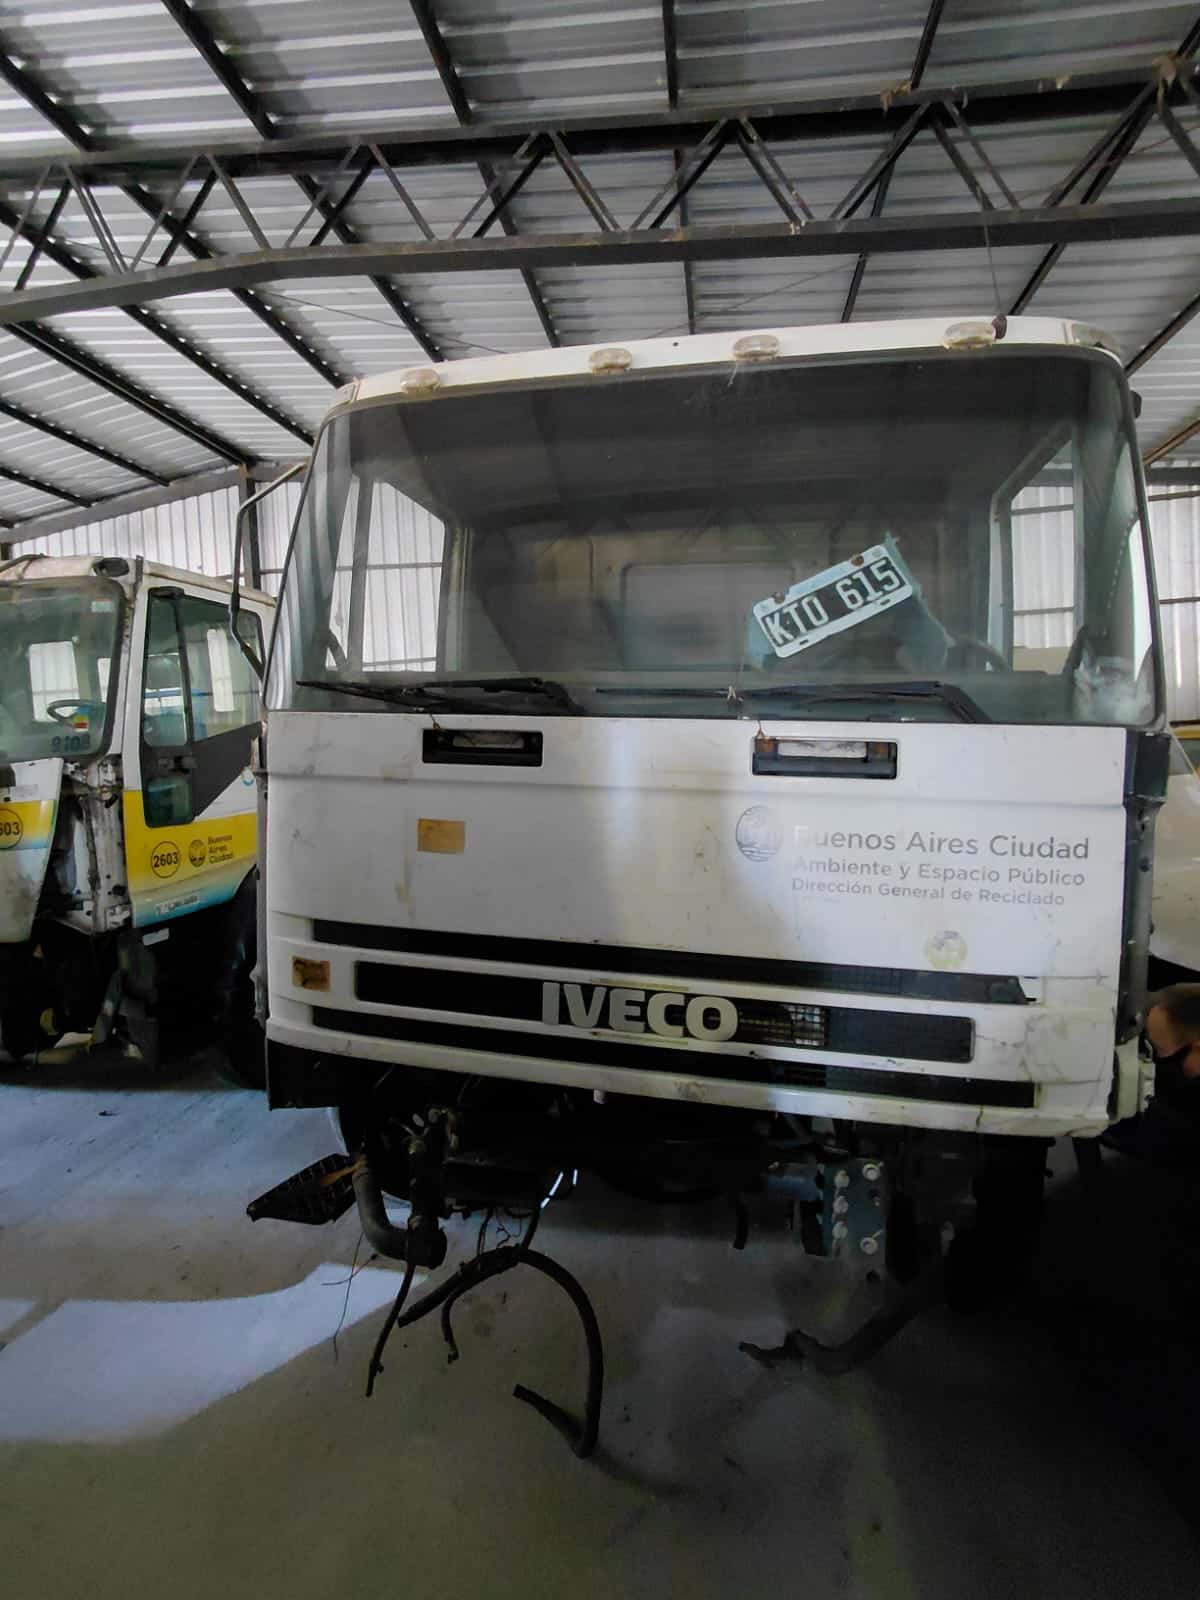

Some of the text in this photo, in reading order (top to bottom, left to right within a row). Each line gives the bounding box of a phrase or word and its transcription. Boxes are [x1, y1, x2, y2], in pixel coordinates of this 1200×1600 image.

[764, 559, 901, 645] KTO 615
[793, 825, 1090, 859] uenos Aires Ciudad
[153, 852, 178, 868] 2603
[793, 856, 1086, 886] Ambiente y Espacio Público
[792, 878, 1065, 905] Dirección General de Reciclado
[541, 981, 738, 1042] IVECO
